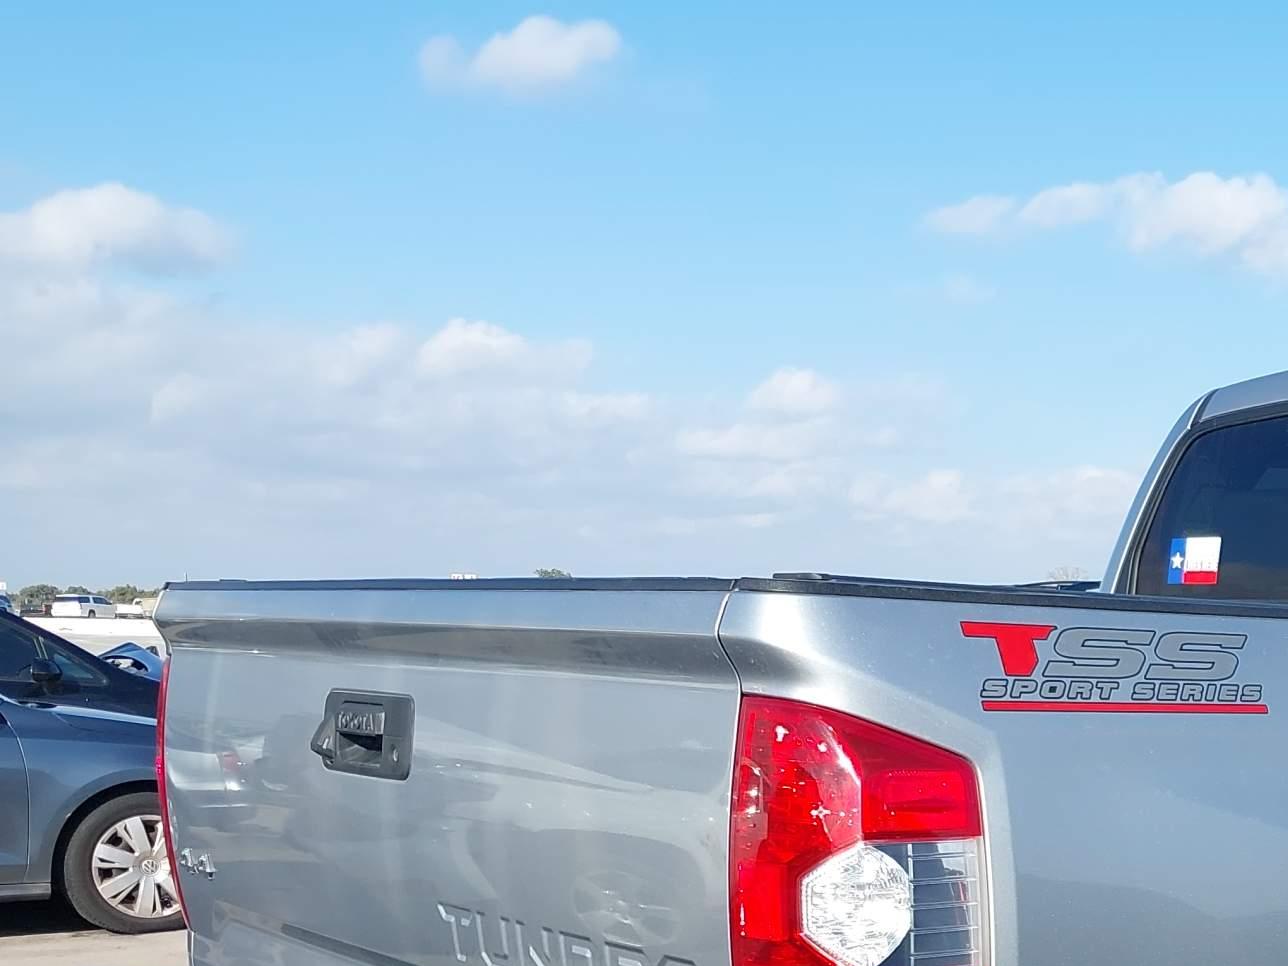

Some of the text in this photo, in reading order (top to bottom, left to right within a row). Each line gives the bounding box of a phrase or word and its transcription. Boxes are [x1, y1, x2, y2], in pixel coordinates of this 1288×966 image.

[960, 621, 1248, 682] TSS
[980, 678, 1263, 703] SPORT SERIES
